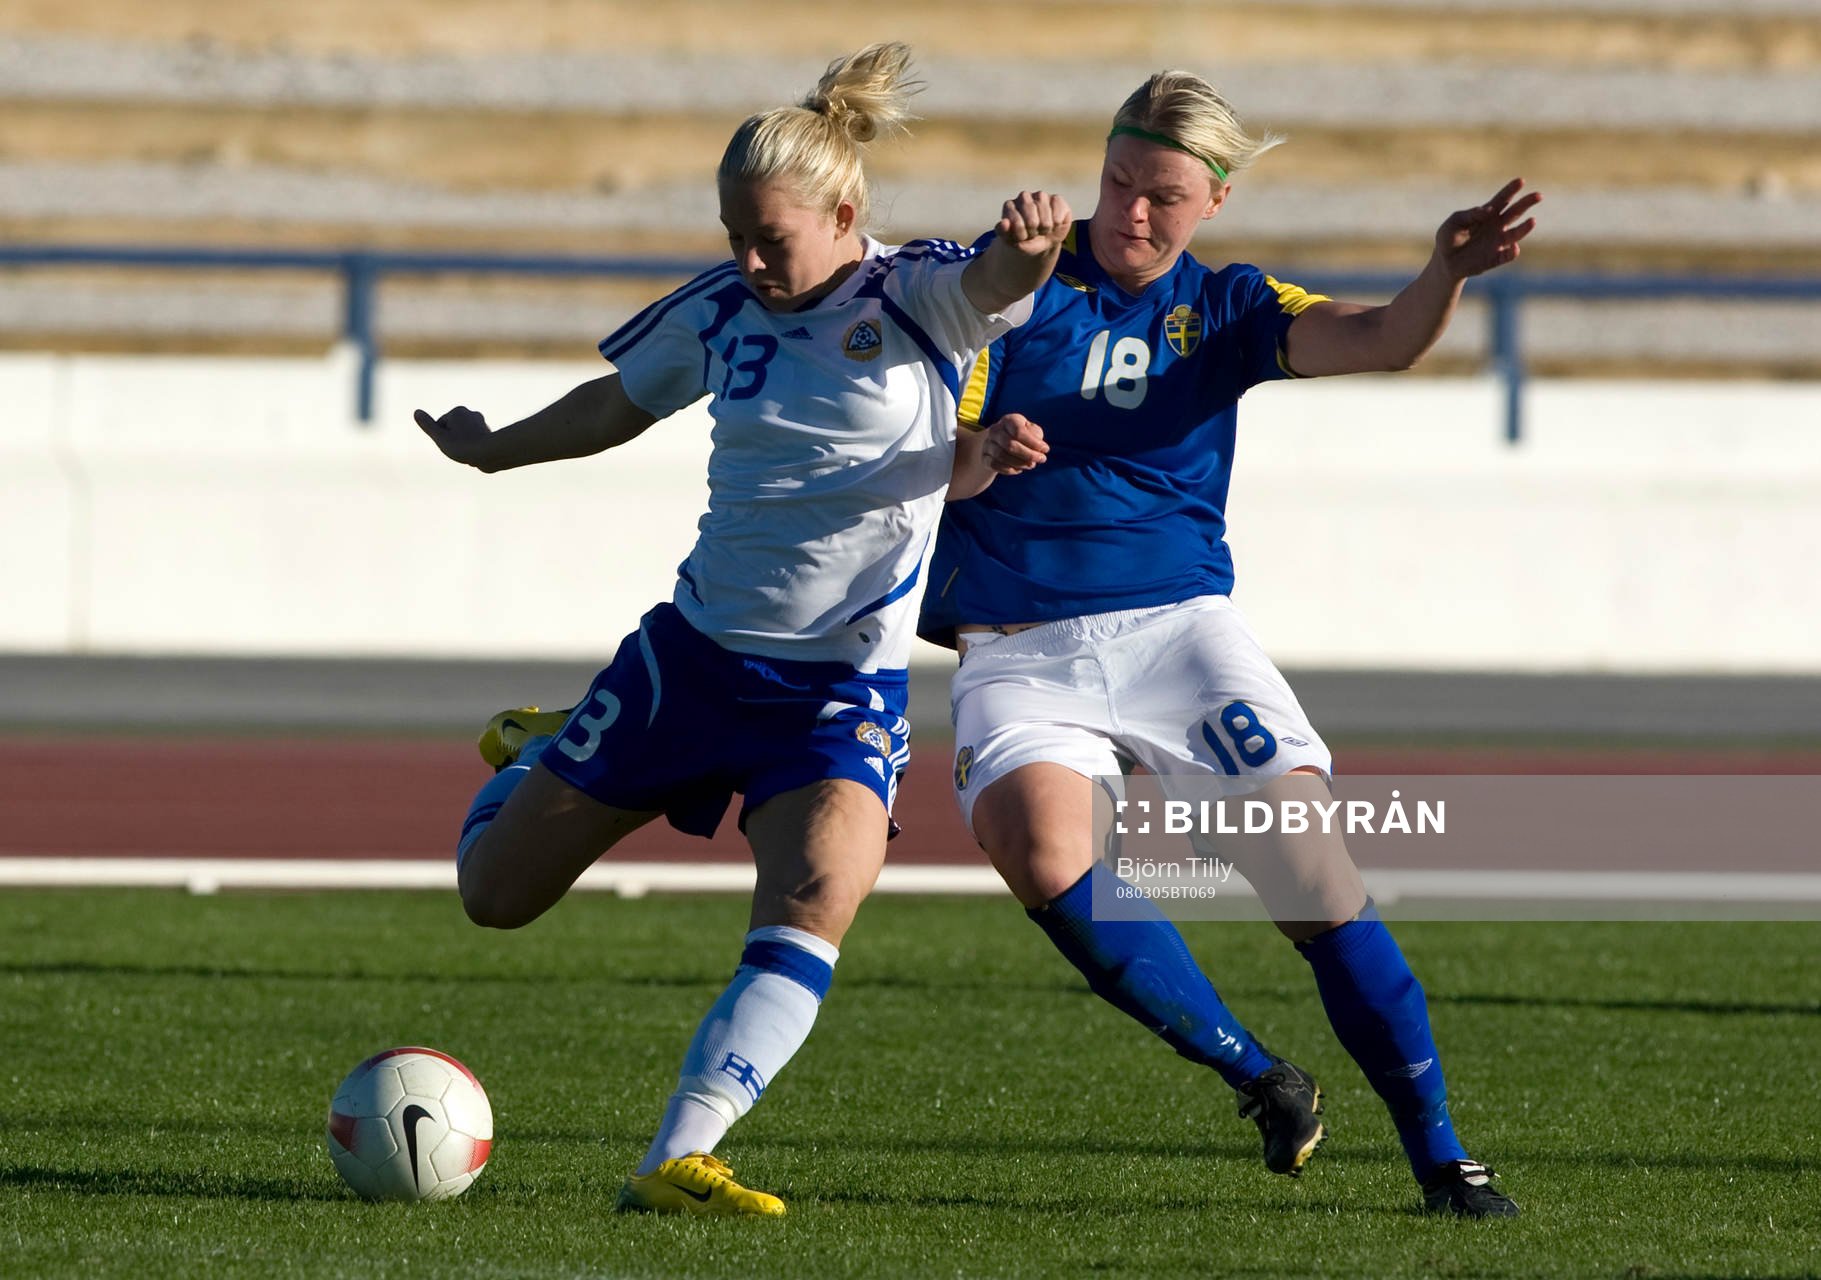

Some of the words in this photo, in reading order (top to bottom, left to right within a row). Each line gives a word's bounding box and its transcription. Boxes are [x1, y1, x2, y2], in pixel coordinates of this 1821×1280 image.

[1081, 330, 1150, 410] 18
[556, 689, 621, 762] 3
[1202, 700, 1277, 776] 18
